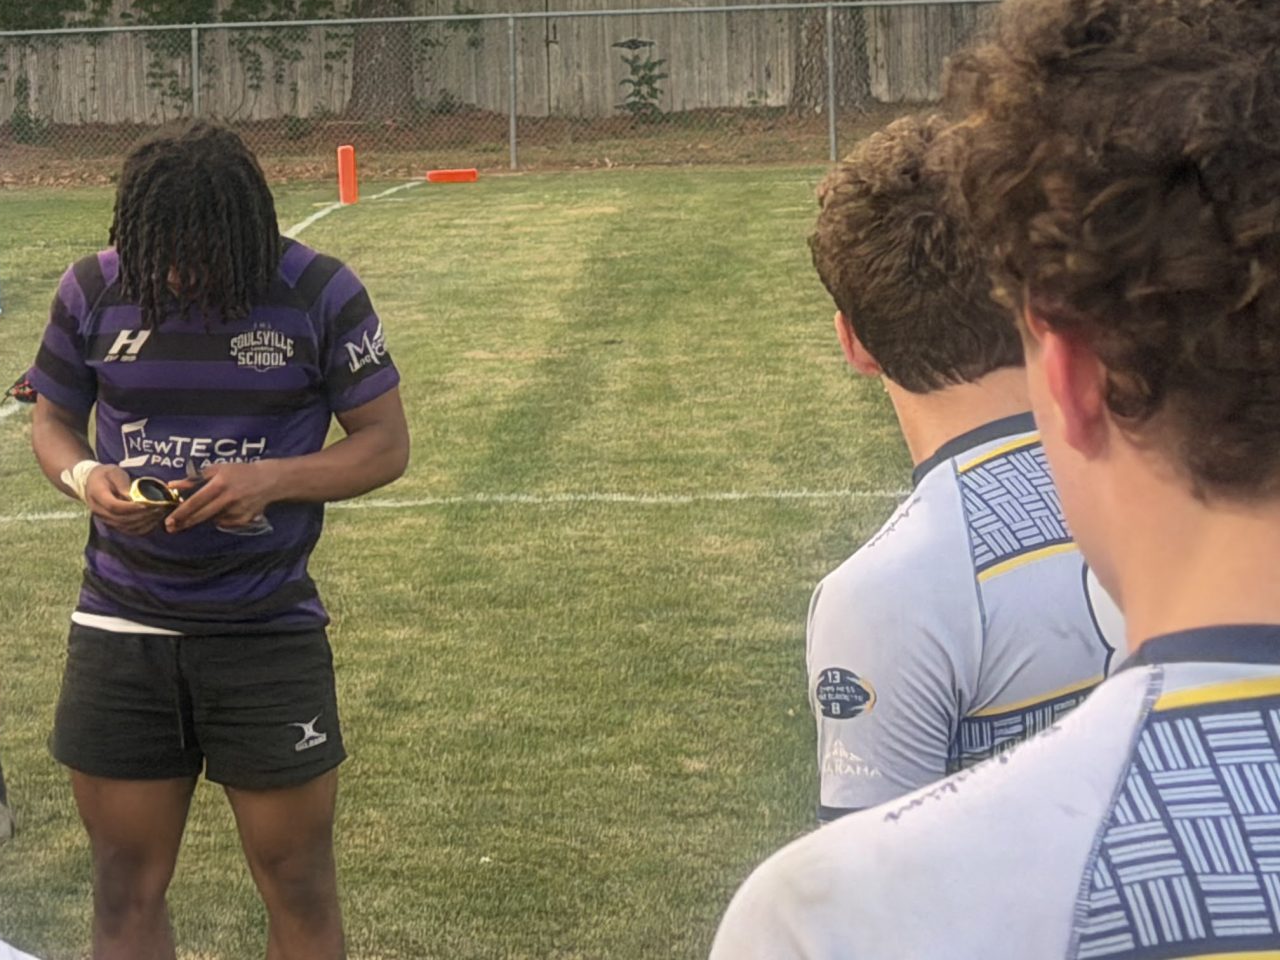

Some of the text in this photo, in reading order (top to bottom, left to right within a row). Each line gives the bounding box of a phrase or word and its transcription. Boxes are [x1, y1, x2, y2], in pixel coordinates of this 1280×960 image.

[229, 331, 294, 357] SOULSVILLE
[237, 351, 287, 366] SCHOOL
[151, 455, 262, 469] PACAGING
[827, 670, 840, 684] 13
